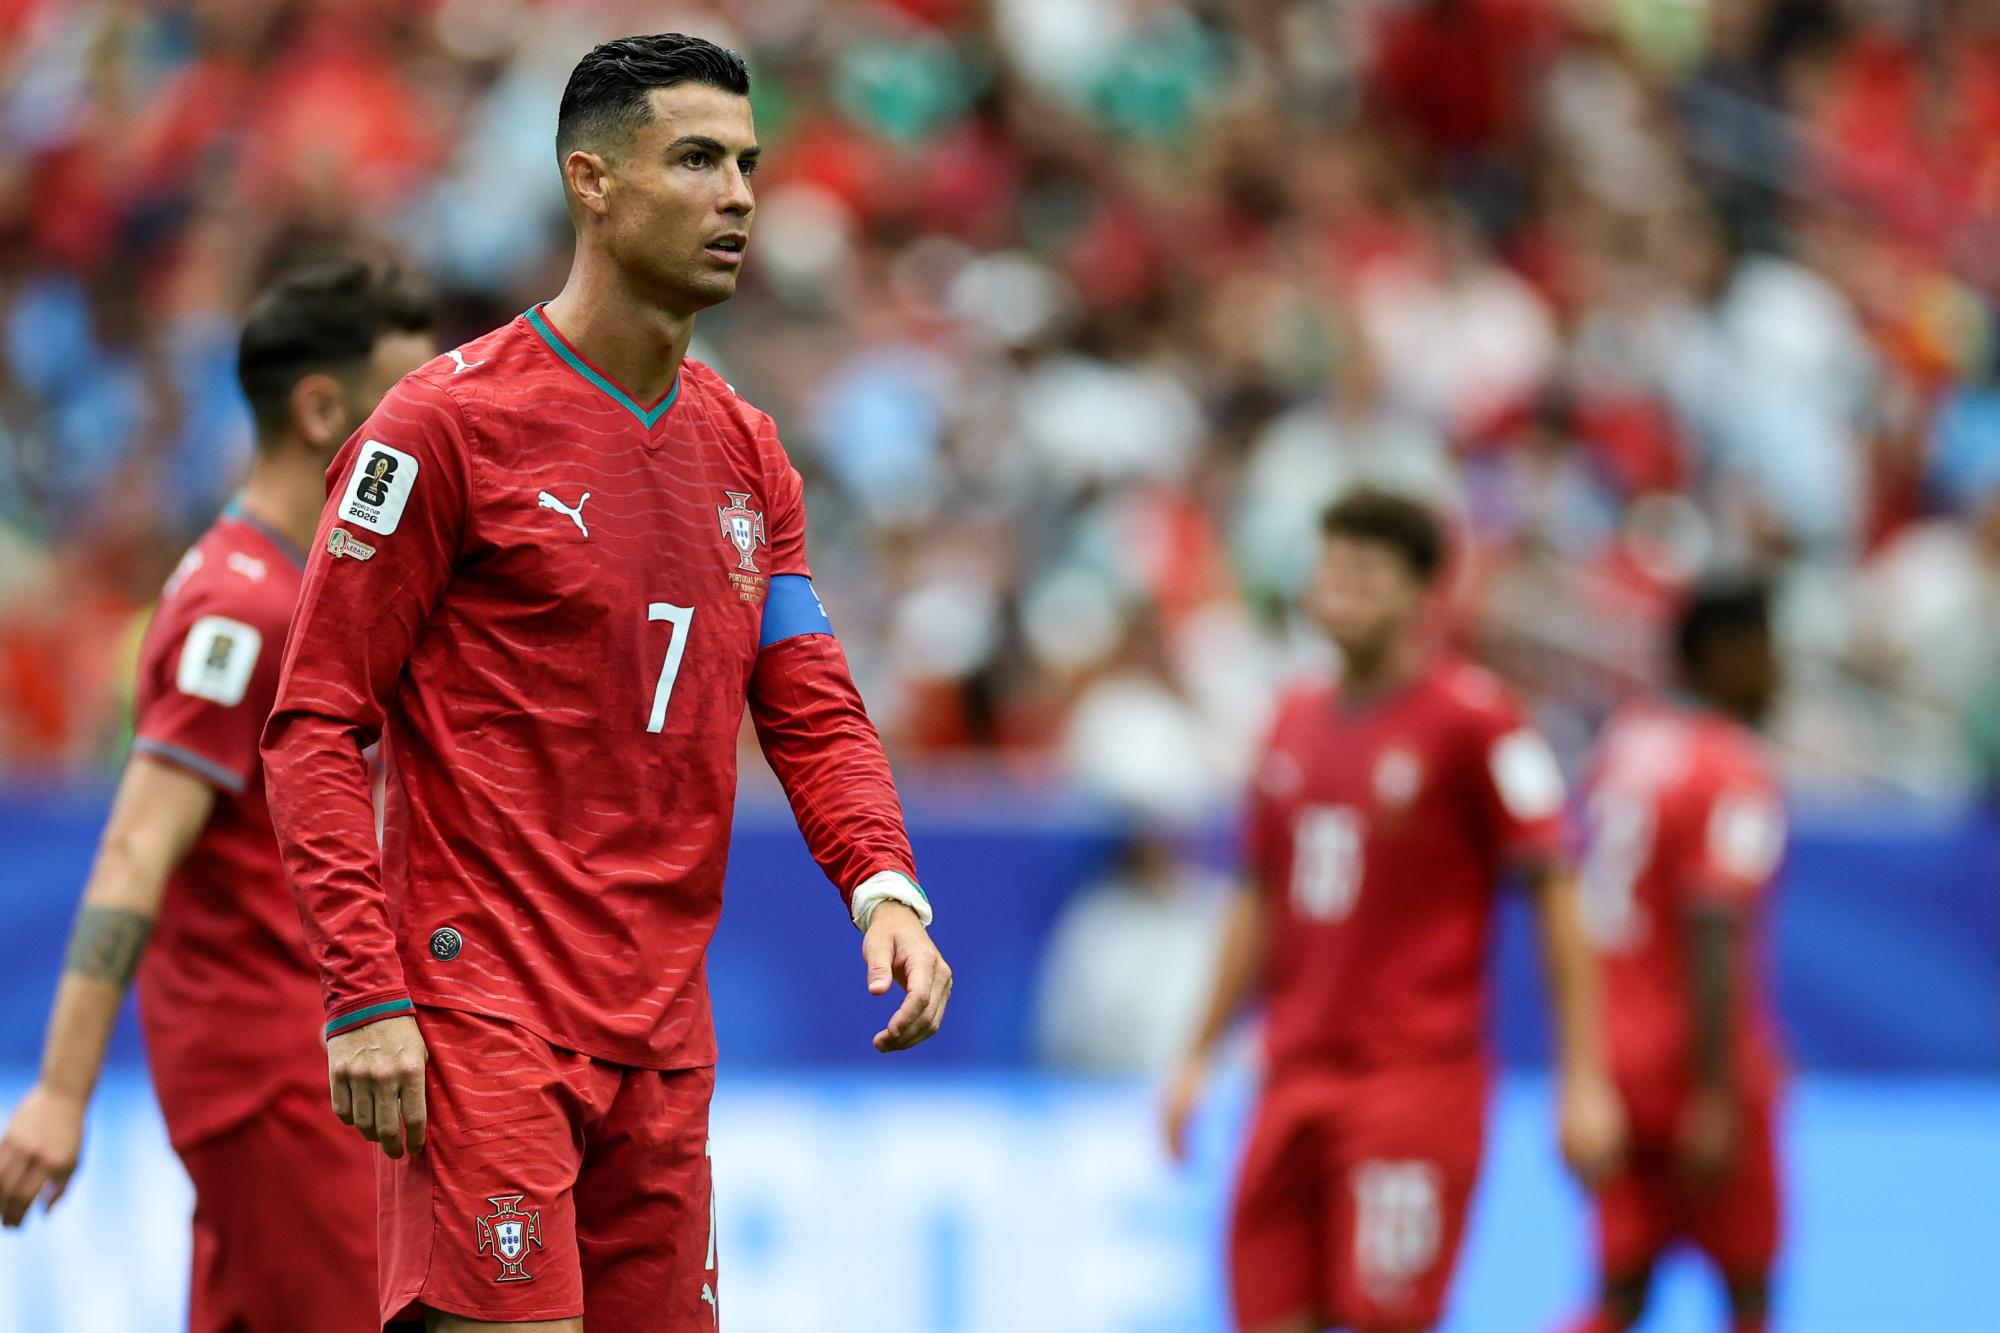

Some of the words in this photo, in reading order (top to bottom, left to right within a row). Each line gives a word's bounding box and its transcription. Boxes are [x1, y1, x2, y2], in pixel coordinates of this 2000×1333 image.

[364, 492, 377, 502] FIFA
[352, 501, 370, 511] WORLD
[349, 507, 378, 524] 2026
[728, 572, 754, 585] PORTUGAL
[646, 602, 696, 734] 7
